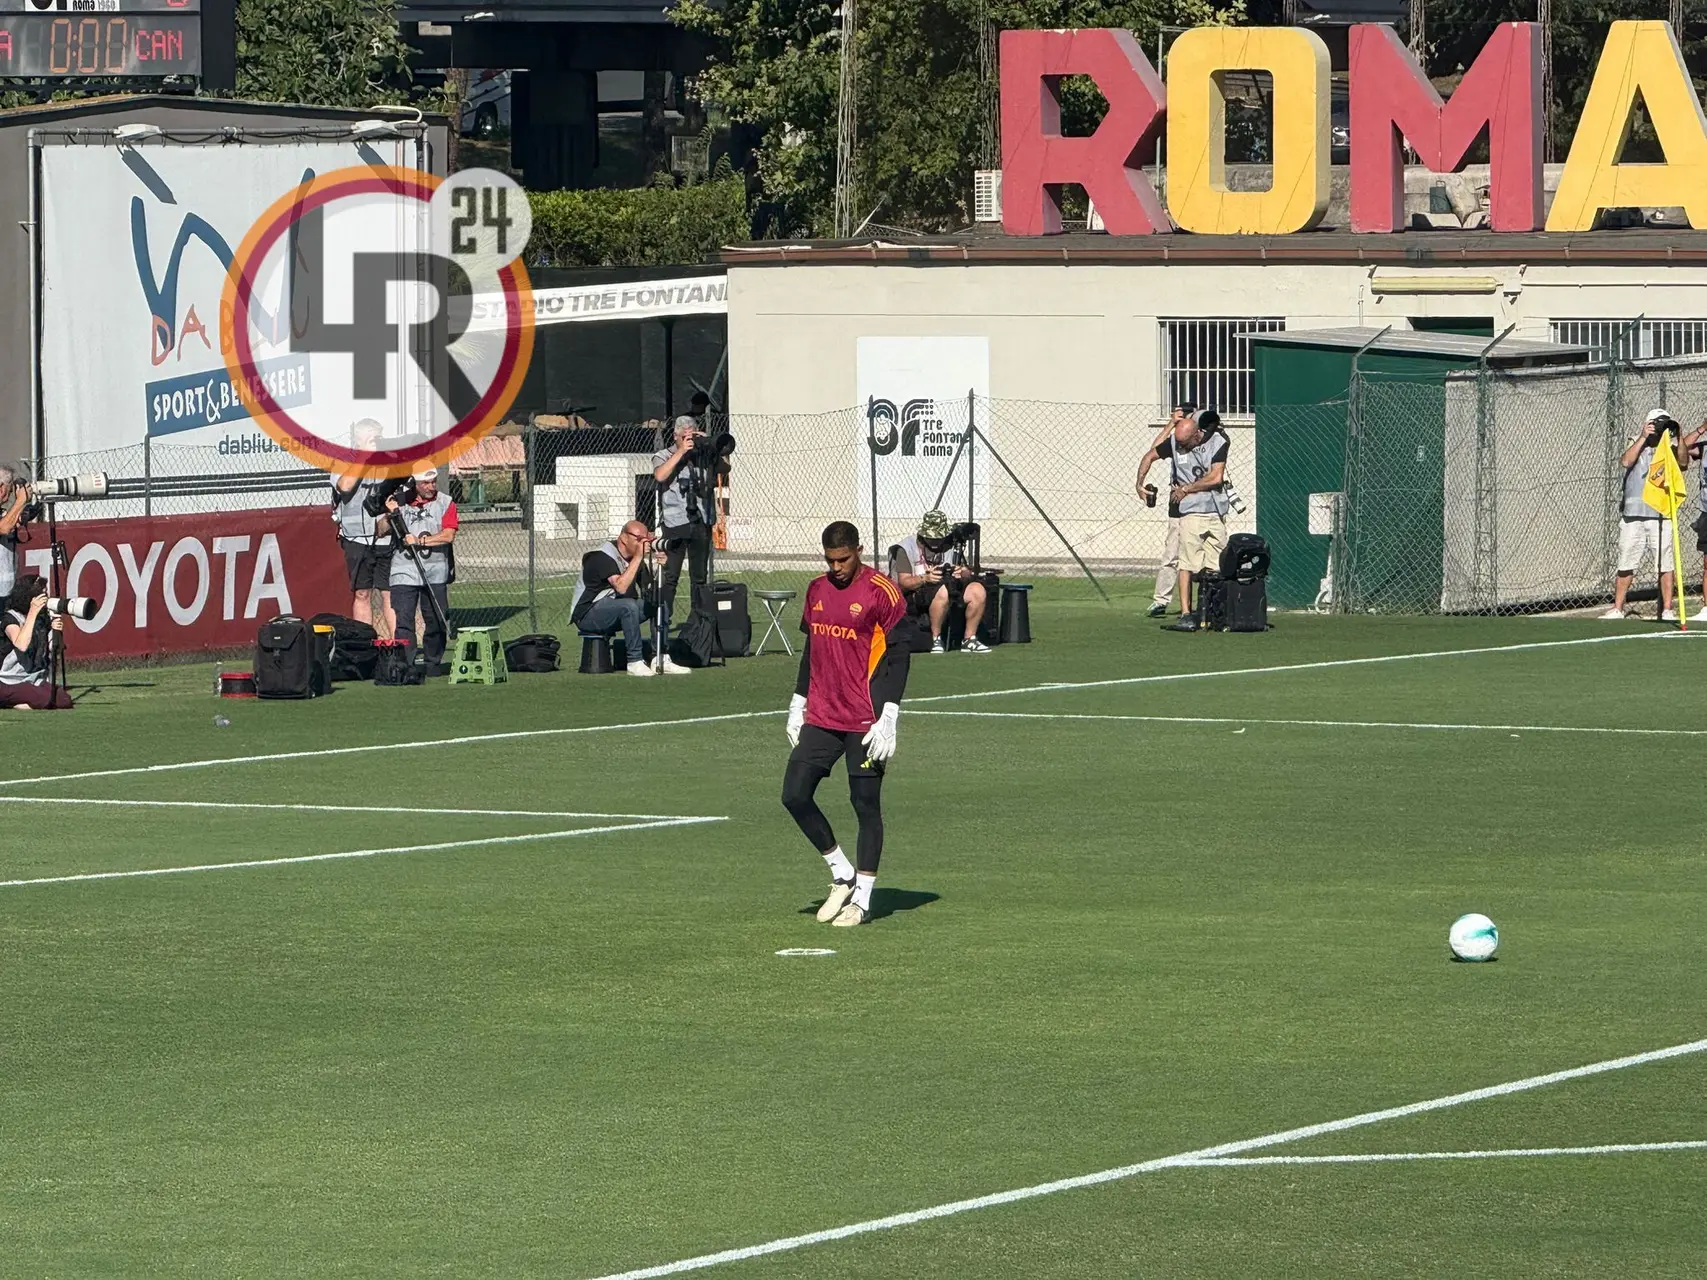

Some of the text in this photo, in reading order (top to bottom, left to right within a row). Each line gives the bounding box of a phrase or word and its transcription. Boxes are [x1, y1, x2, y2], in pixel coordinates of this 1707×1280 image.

[135, 30, 183, 61] CAN
[1000, 20, 1707, 236] ROMA
[568, 291, 617, 313] TRE
[217, 432, 319, 456] dabliu.com
[25, 533, 294, 634] TOYOTA
[811, 622, 858, 641] TOYOTA
